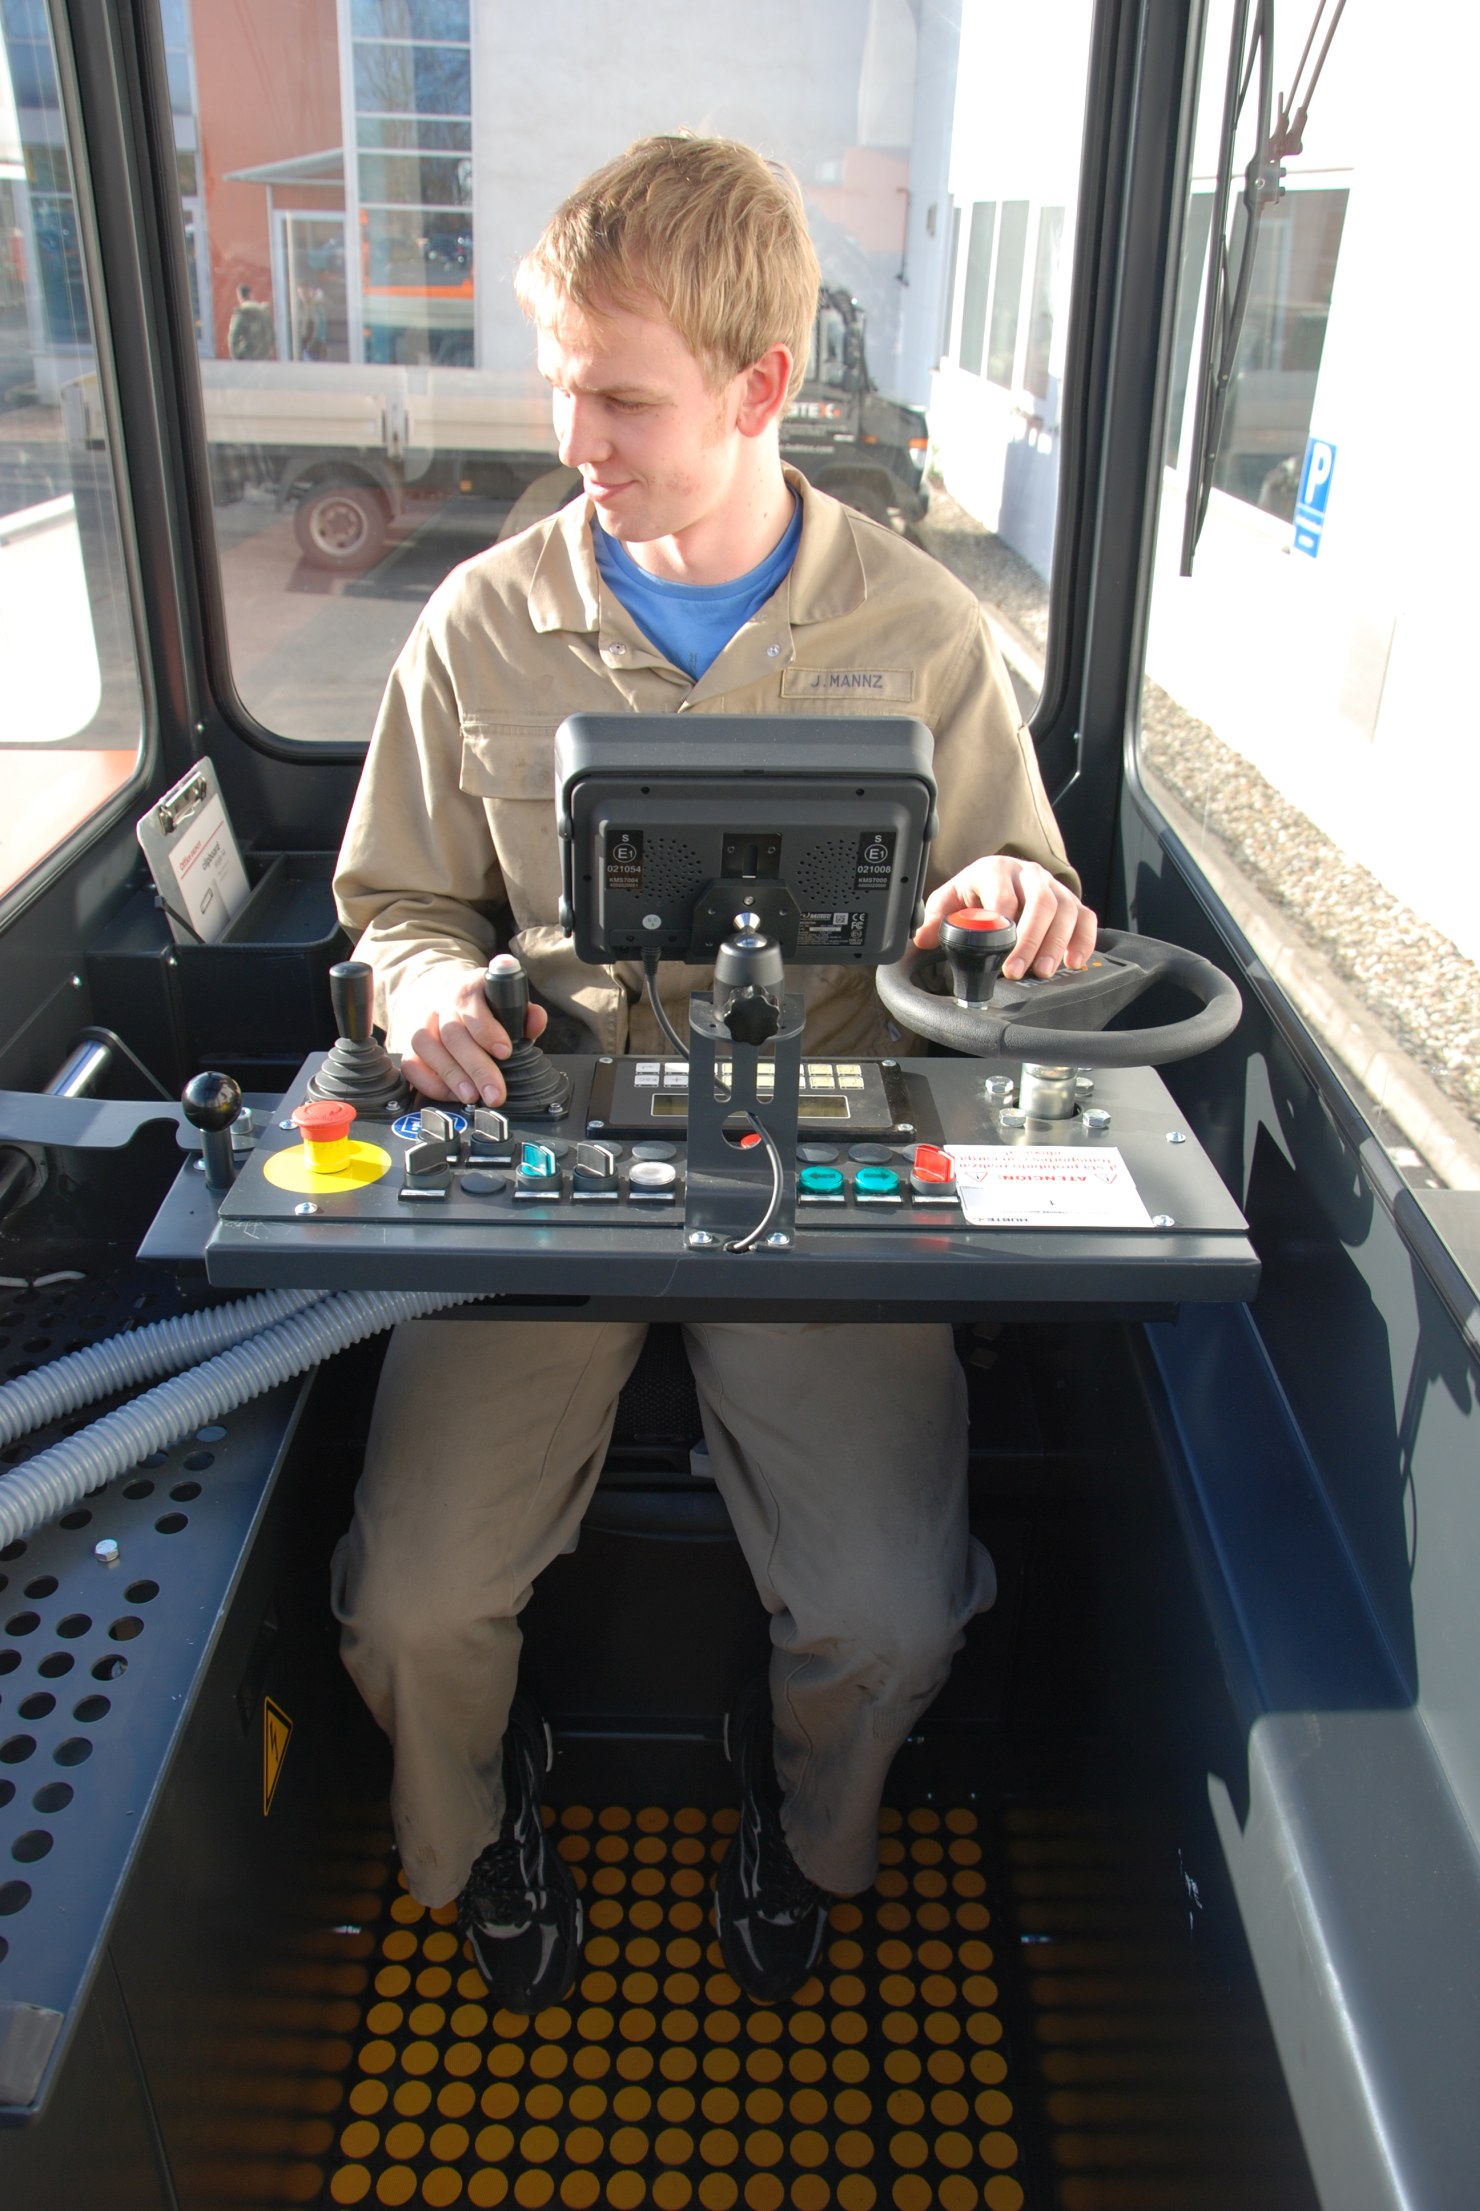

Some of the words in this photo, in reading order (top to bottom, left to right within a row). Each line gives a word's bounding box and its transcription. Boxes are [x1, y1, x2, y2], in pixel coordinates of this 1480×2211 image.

[1304, 442, 1333, 505] P
[622, 834, 630, 842] S
[874, 834, 882, 843] S
[607, 865, 641, 873] 021054
[857, 866, 891, 874] 021008
